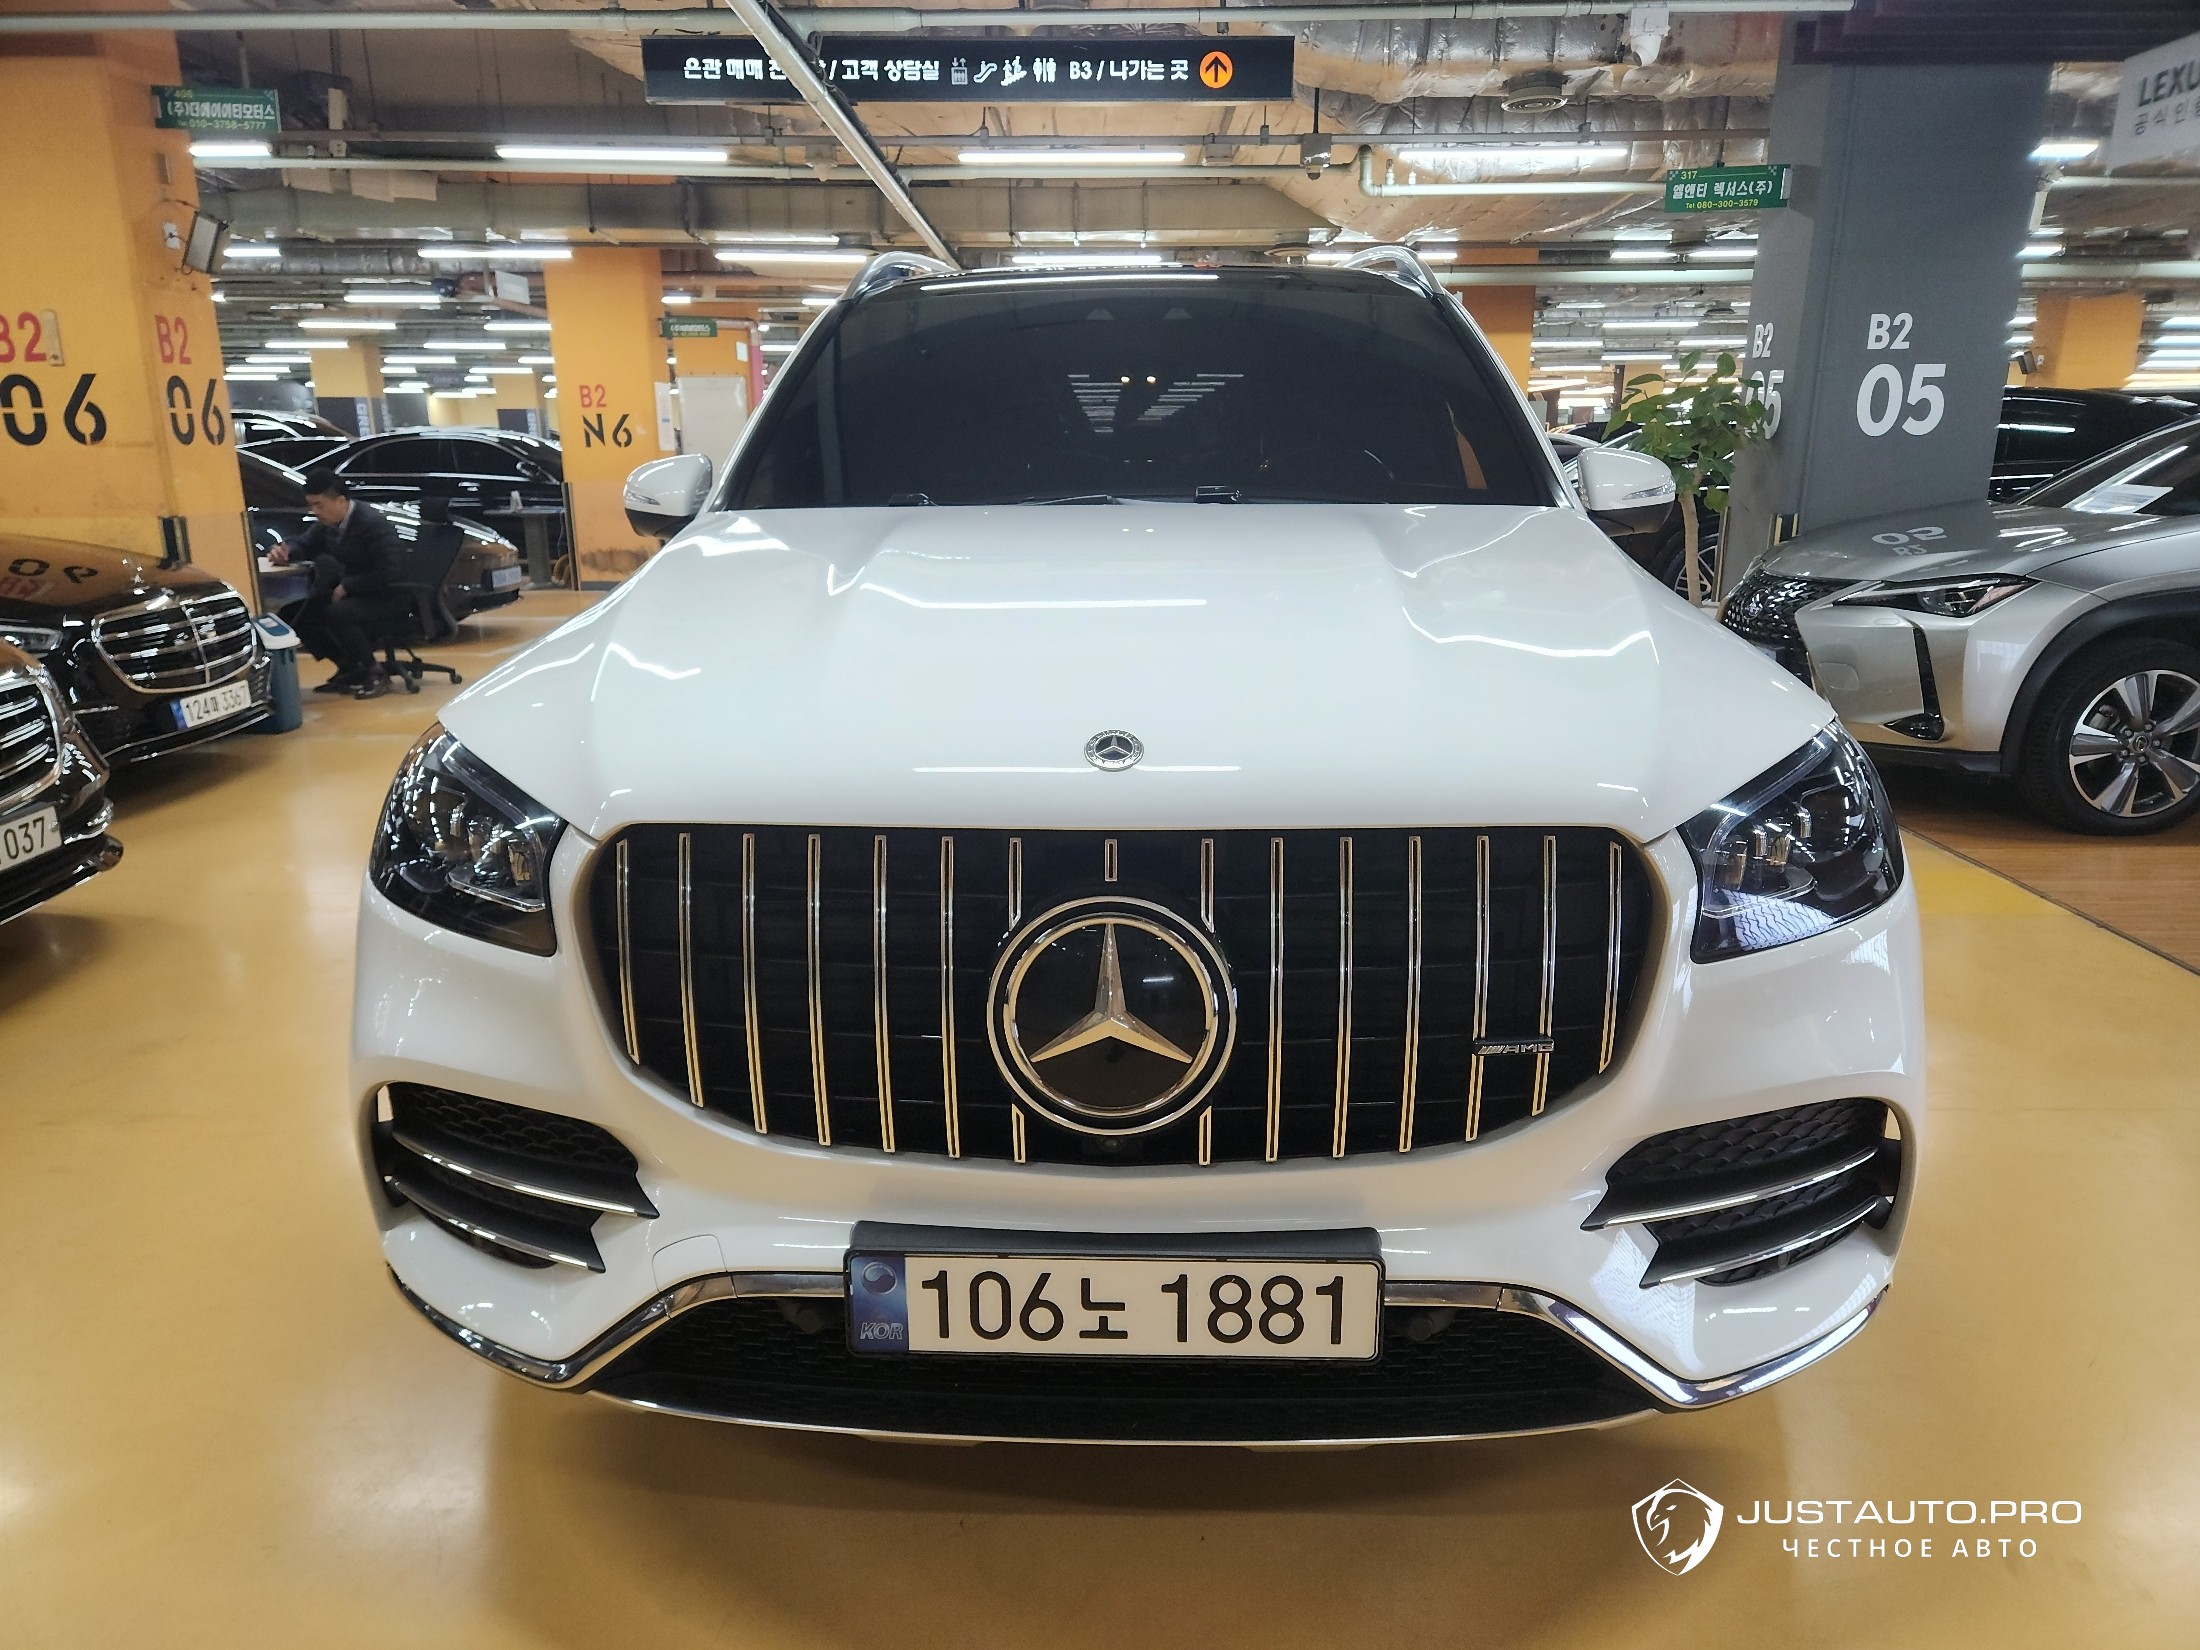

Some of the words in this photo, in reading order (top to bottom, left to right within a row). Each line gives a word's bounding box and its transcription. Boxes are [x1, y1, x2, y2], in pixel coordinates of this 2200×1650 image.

[726, 59, 763, 80] 매매
[842, 60, 878, 80] 고객
[884, 60, 940, 81] 상담실
[1069, 60, 1092, 79] B3
[1110, 60, 1165, 81] 나가는
[1170, 60, 1189, 80] 곳
[1681, 171, 1698, 180] 317
[1714, 180, 1773, 197] 렉서스(주)
[1697, 200, 1759, 209] 080-300-3579
[155, 315, 192, 365] B2
[1752, 322, 1774, 359] B2
[1867, 312, 1913, 350] B2
[0, 373, 107, 446] 06
[166, 375, 226, 446] 06
[579, 384, 607, 408] B2
[1856, 363, 1947, 437] 05
[582, 413, 632, 448] N6
[0, 816, 45, 865] 037
[1503, 1043, 1554, 1054] AMG
[922, 1270, 1128, 1341] 106노
[1161, 1273, 1344, 1345] 1881
[860, 1322, 904, 1340] KOR
